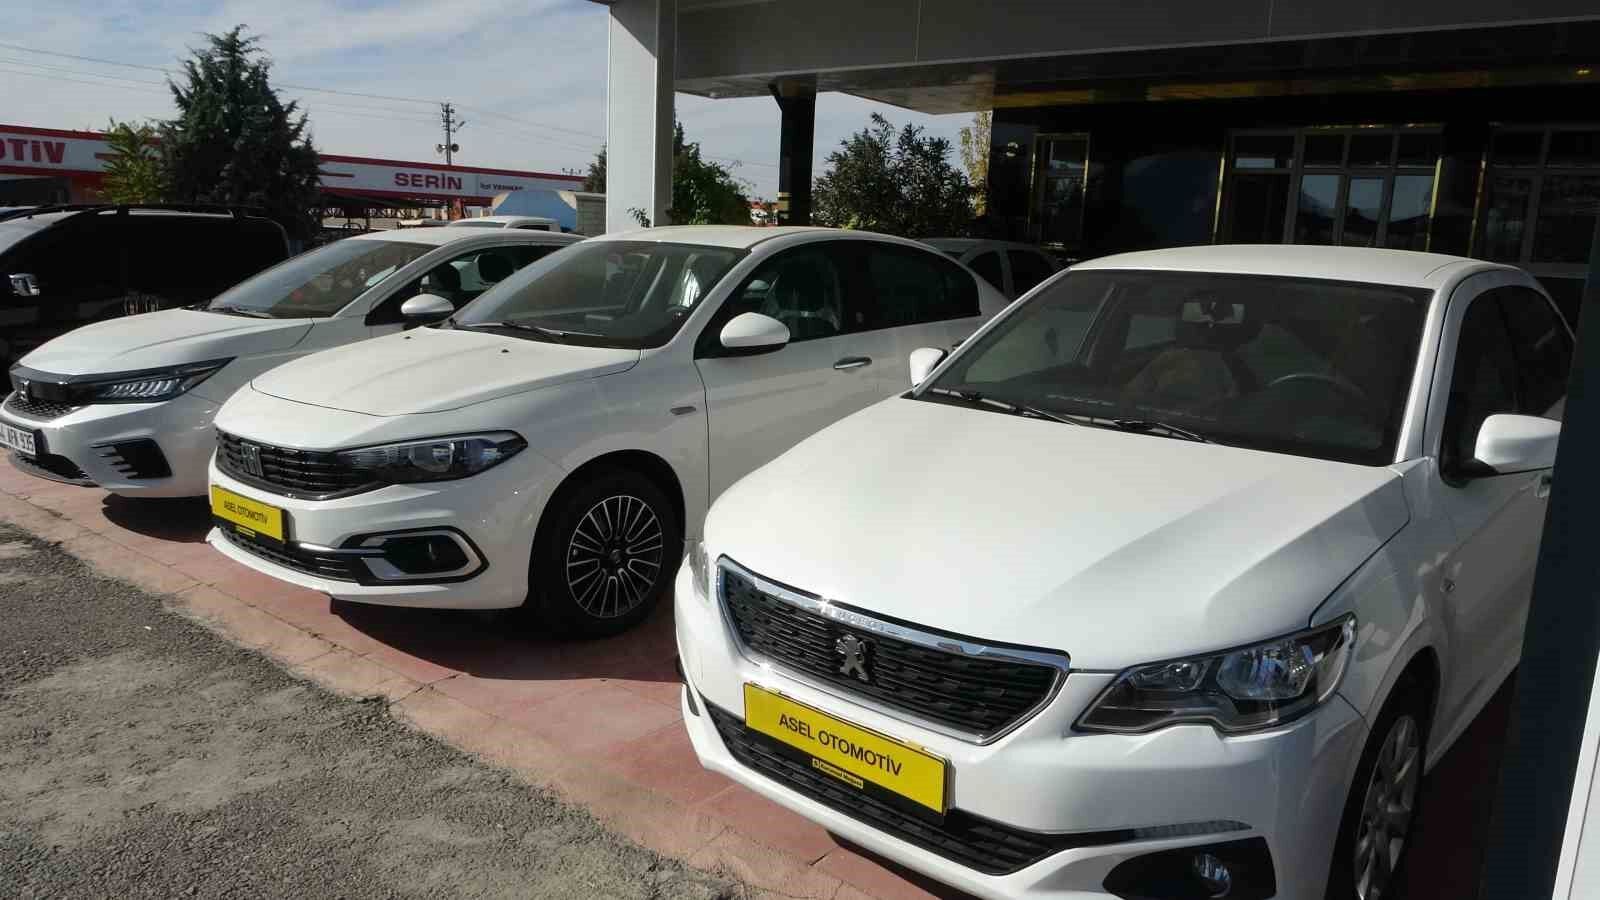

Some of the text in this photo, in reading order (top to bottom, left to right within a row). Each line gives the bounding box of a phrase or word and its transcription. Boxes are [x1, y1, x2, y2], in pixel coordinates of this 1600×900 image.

[394, 172, 462, 190] SERİN
[778, 713, 816, 741] ASEL
[818, 729, 902, 777] OTOMOTİV
